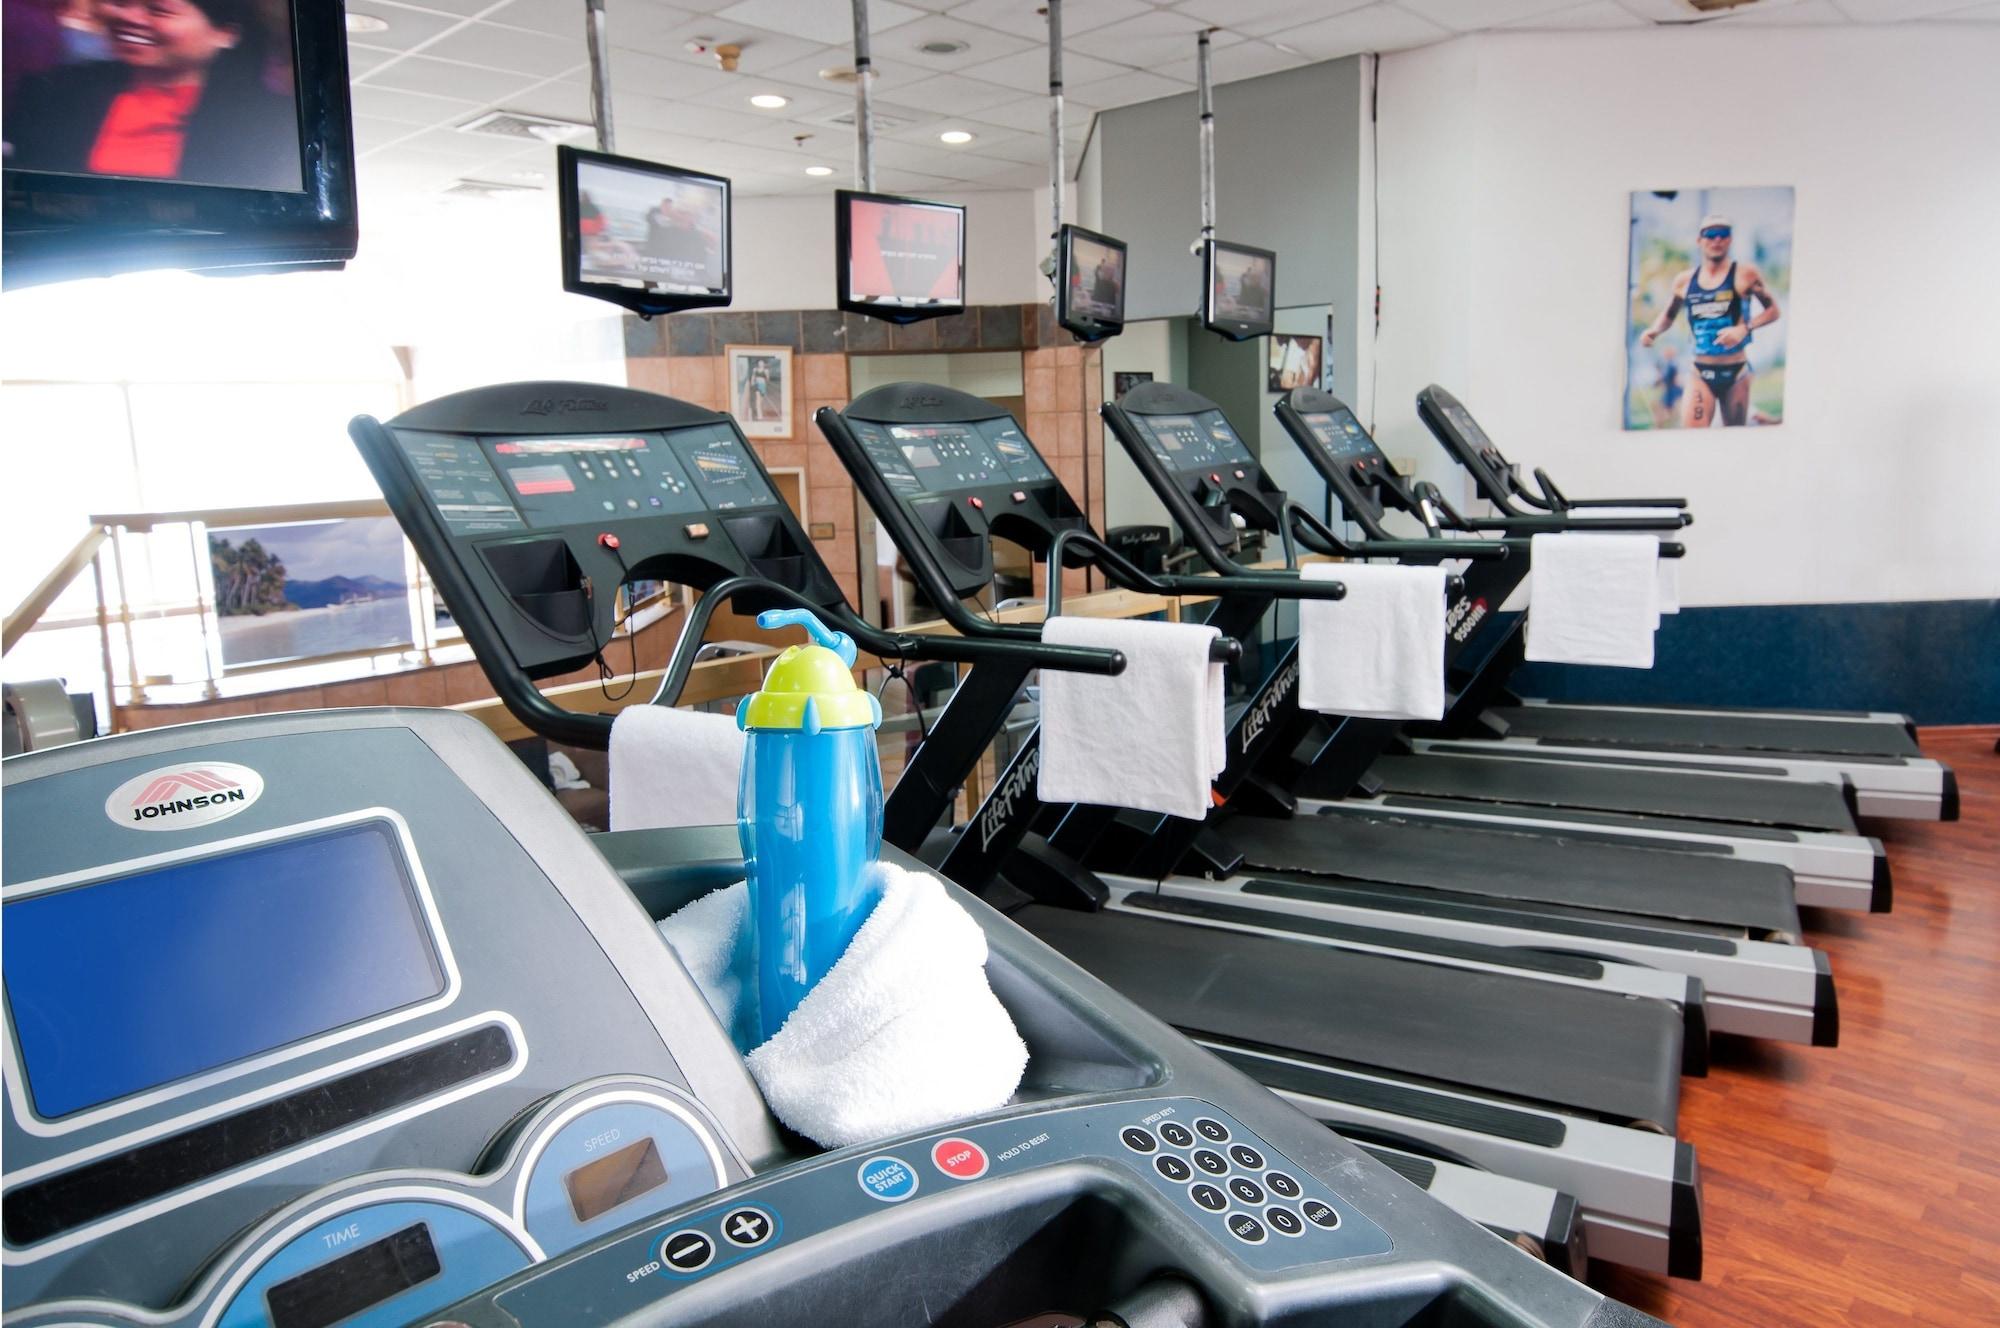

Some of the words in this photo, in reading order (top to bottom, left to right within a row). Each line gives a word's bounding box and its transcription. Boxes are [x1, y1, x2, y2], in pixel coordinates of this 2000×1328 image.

[134, 789, 245, 821] JOHNSON
[1142, 1113, 1162, 1126] SPEED
[584, 1128, 620, 1153] SPEED
[997, 1147, 1020, 1162] HOLD
[1019, 1141, 1032, 1153] TO
[1030, 1132, 1050, 1147] RESET
[1131, 1134, 1145, 1146] 1
[1168, 1129, 1184, 1141] 2
[1205, 1125, 1219, 1137] 3
[946, 1150, 972, 1168] STOP
[1167, 1162, 1180, 1175] 4
[1204, 1156, 1218, 1169] 5
[1241, 1152, 1254, 1163] 6
[866, 1163, 902, 1186] QUICK
[875, 1171, 907, 1193] START
[1202, 1191, 1216, 1206] 7
[1239, 1185, 1255, 1198] 8
[1276, 1179, 1290, 1192] 9
[1235, 1220, 1256, 1236] RESET
[1310, 1207, 1331, 1222] ENTER
[323, 1223, 360, 1249] TIME
[626, 1260, 661, 1283] SPEED
